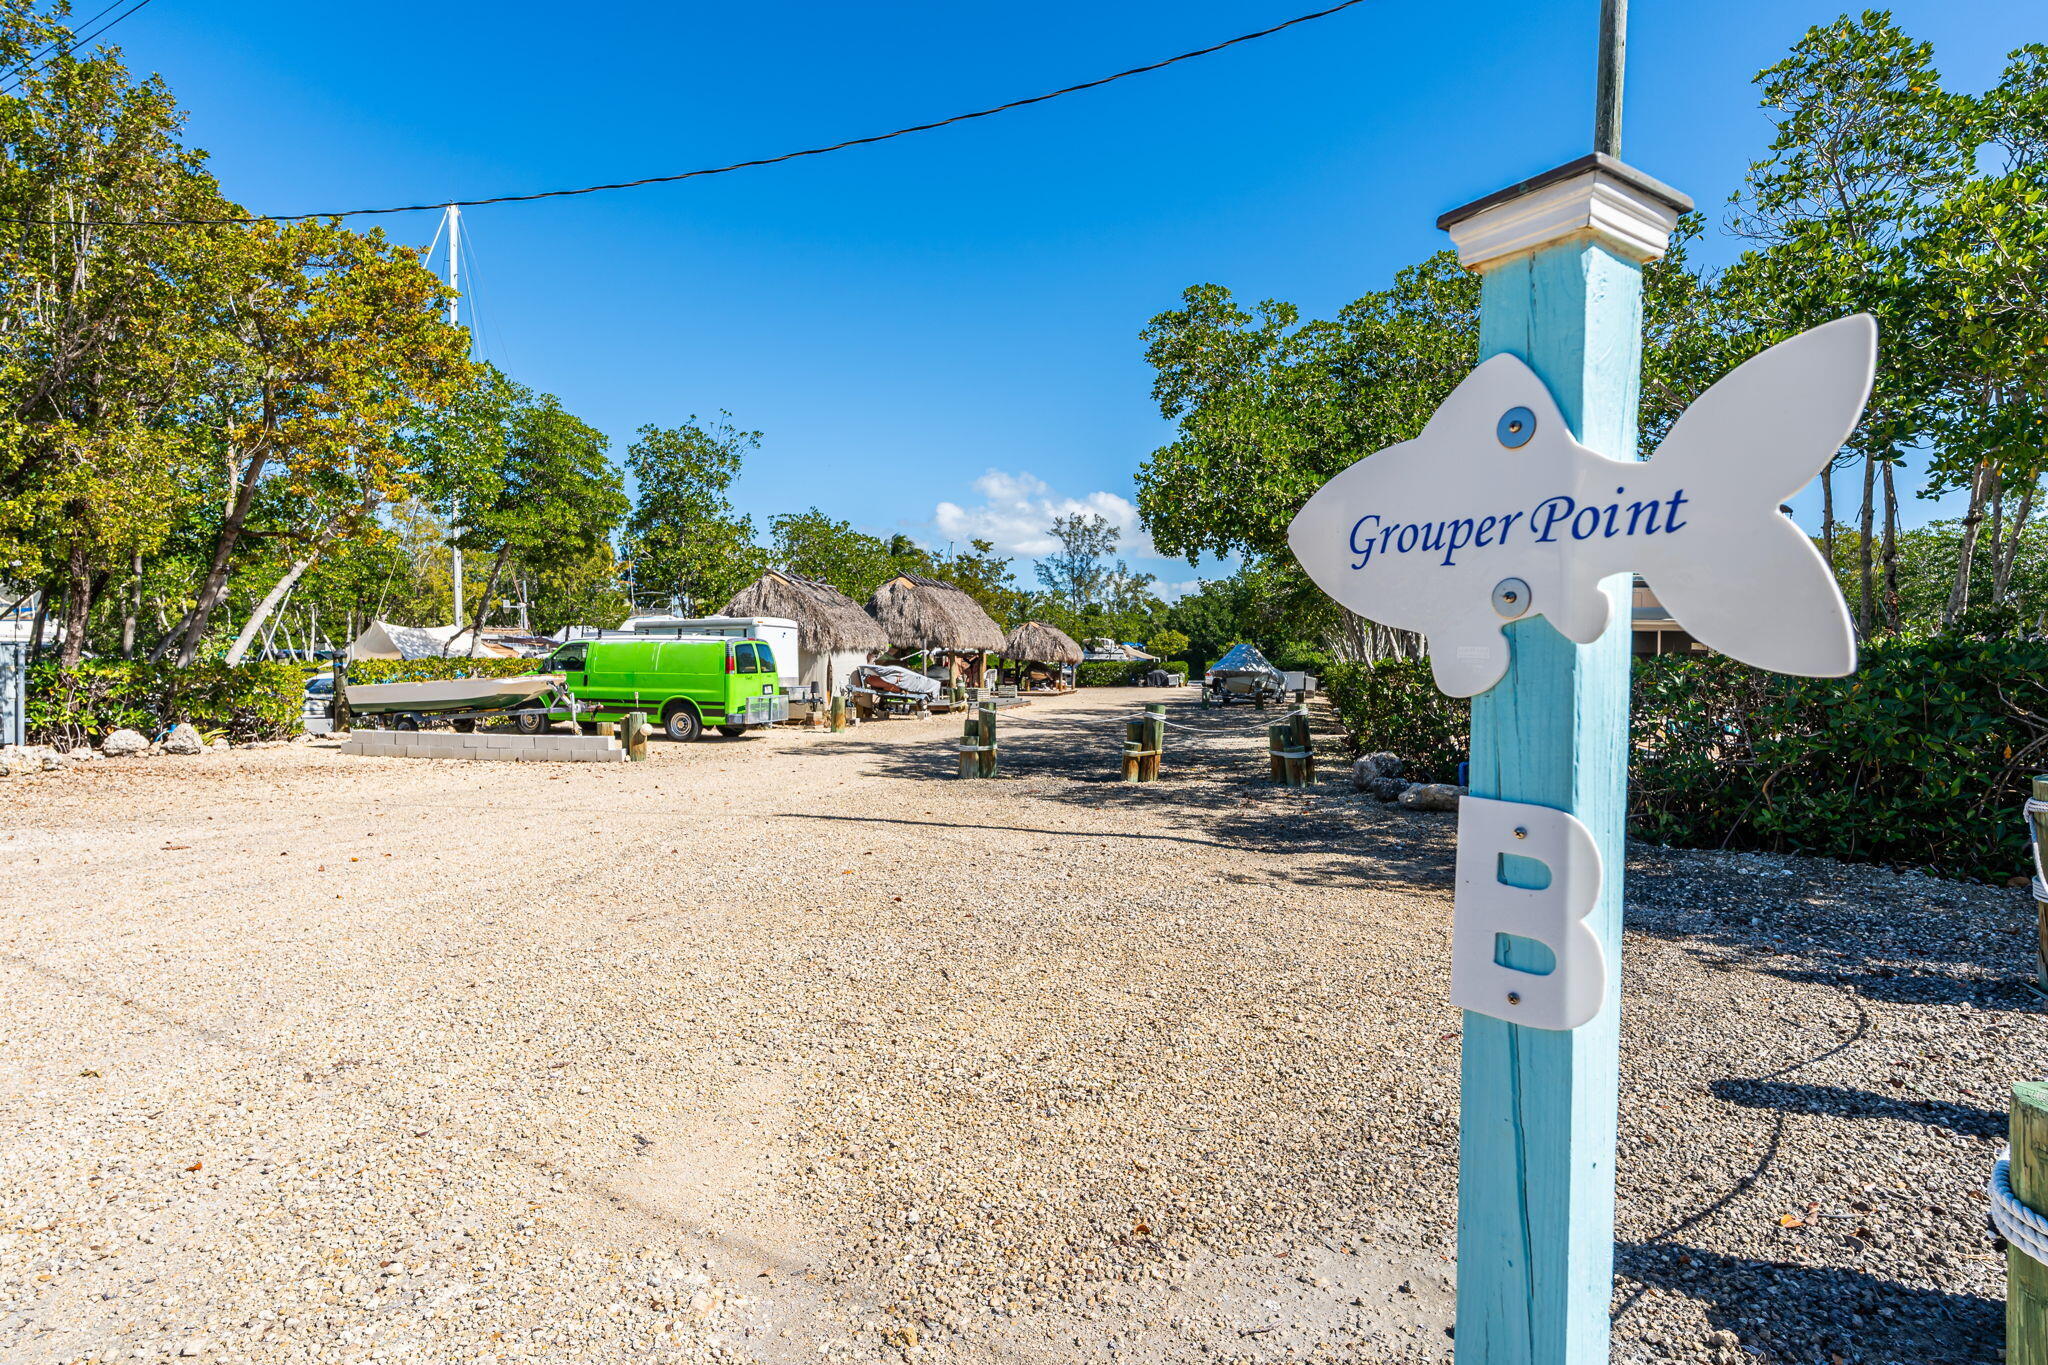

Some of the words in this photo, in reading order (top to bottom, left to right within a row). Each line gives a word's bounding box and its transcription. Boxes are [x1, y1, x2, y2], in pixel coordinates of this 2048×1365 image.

[1348, 510, 1524, 571] Grouper
[1529, 486, 1690, 544] Point
[1449, 795, 1606, 1031] B
